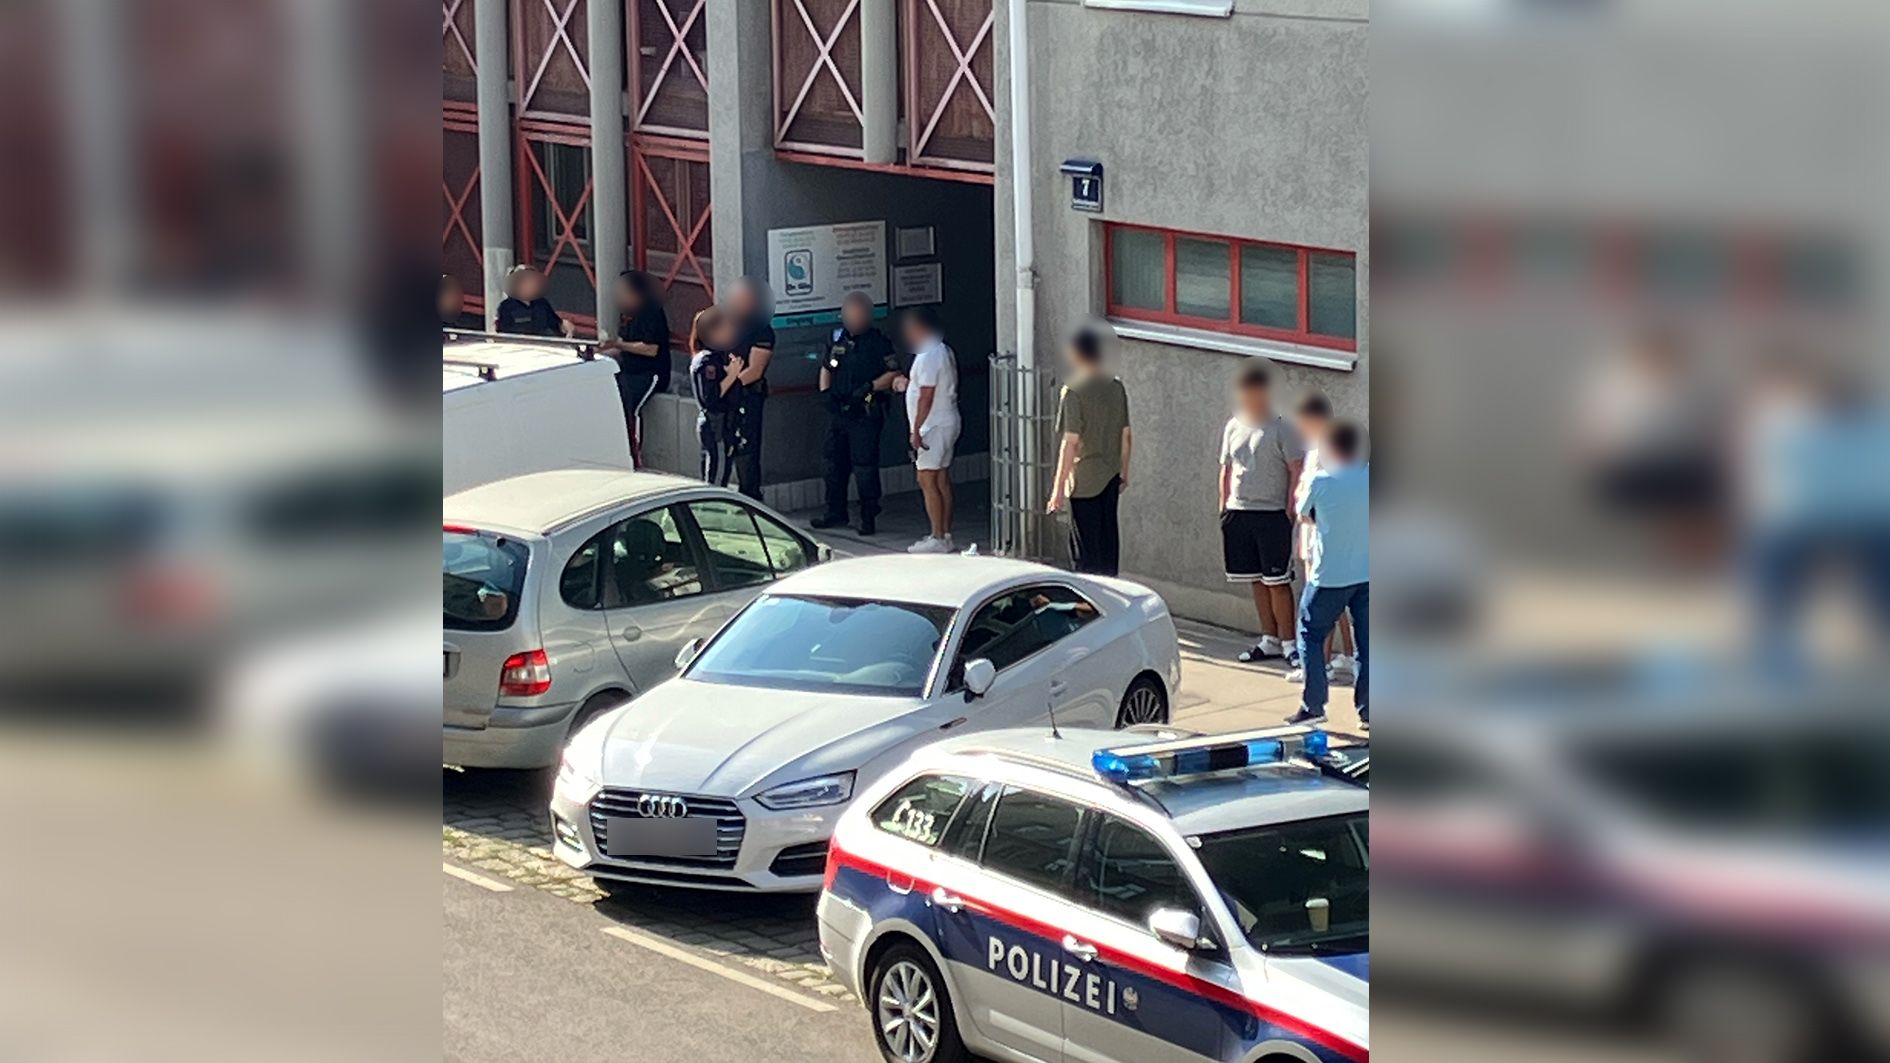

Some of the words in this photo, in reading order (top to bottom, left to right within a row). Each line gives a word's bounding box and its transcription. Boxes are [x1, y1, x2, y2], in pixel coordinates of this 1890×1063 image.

[1082, 179, 1090, 197] 7
[904, 808, 935, 842] 133
[988, 936, 1115, 1014] POLIZEI
